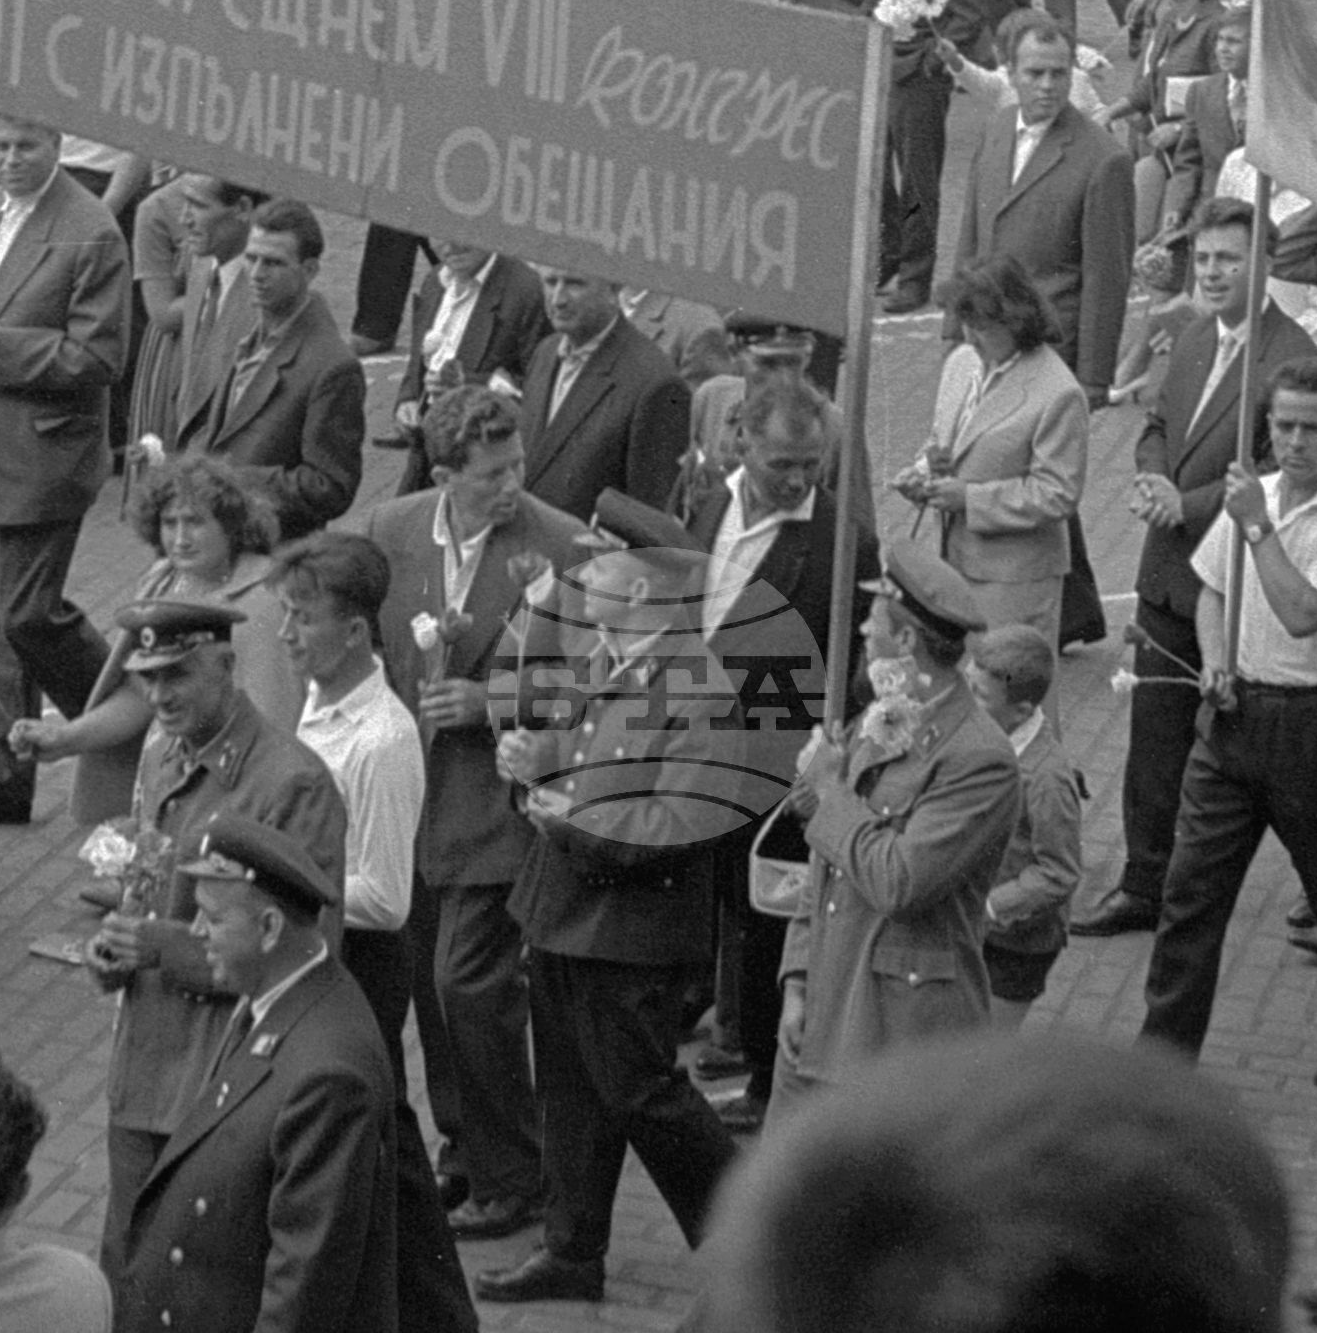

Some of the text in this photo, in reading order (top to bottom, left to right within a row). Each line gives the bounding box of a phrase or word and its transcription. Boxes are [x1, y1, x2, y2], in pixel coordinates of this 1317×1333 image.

[45, 12, 83, 100] С
[99, 26, 404, 193] ИЗПЪЛНЕНИ
[433, 125, 799, 292] ОБЕЩАНИЯ
